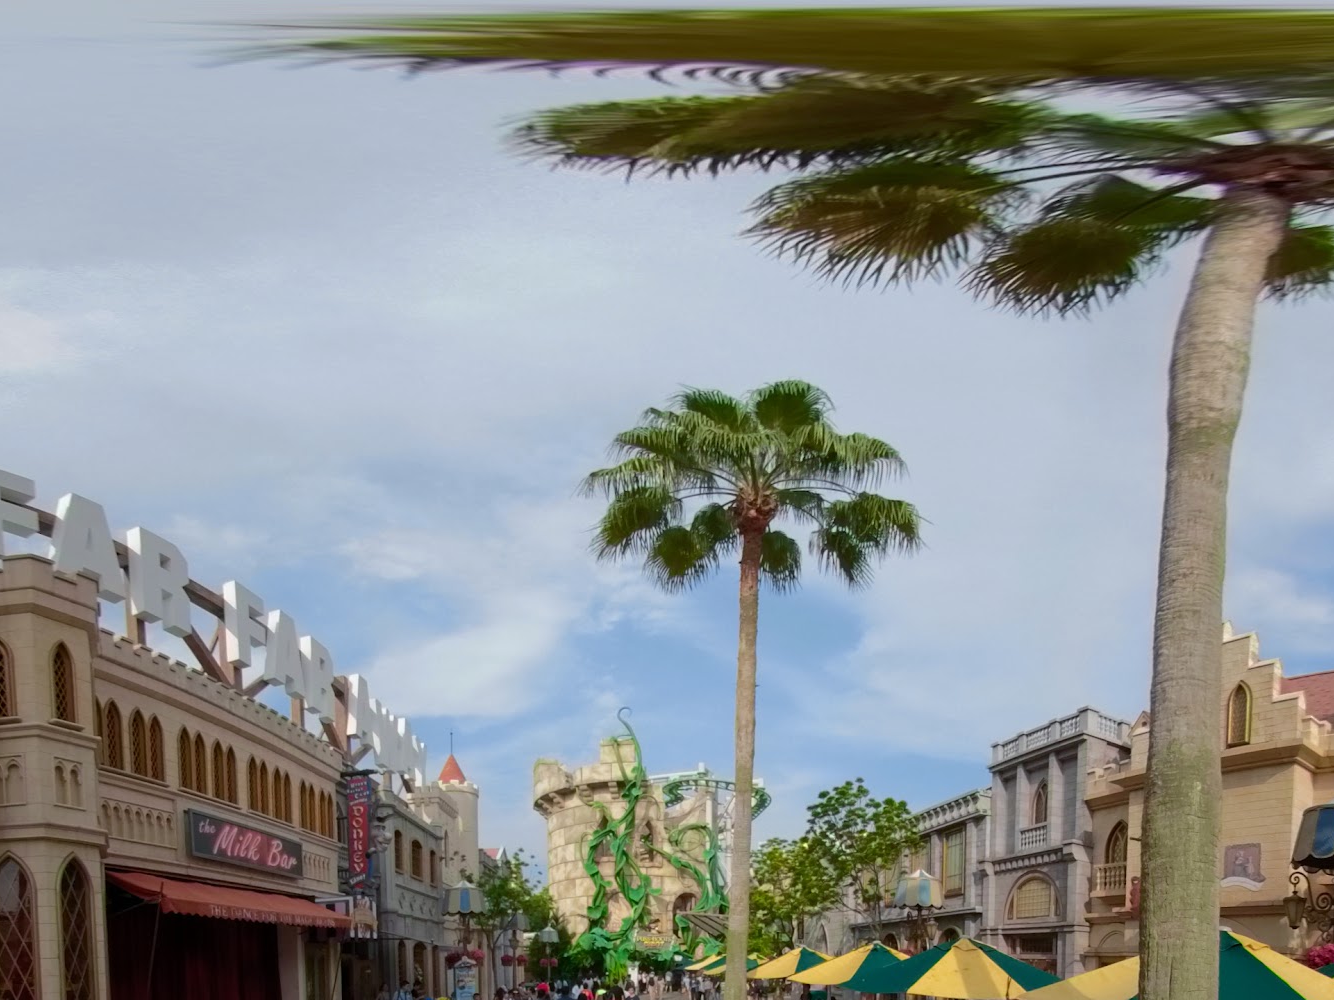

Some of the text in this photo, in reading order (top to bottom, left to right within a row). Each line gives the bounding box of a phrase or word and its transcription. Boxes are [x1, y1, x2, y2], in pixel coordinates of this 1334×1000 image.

[222, 579, 335, 724] FAR
[198, 818, 298, 870] the Milk Bar
[352, 805, 364, 873] DONKEY
[209, 904, 228, 917] THE
[261, 911, 277, 922] FOR
